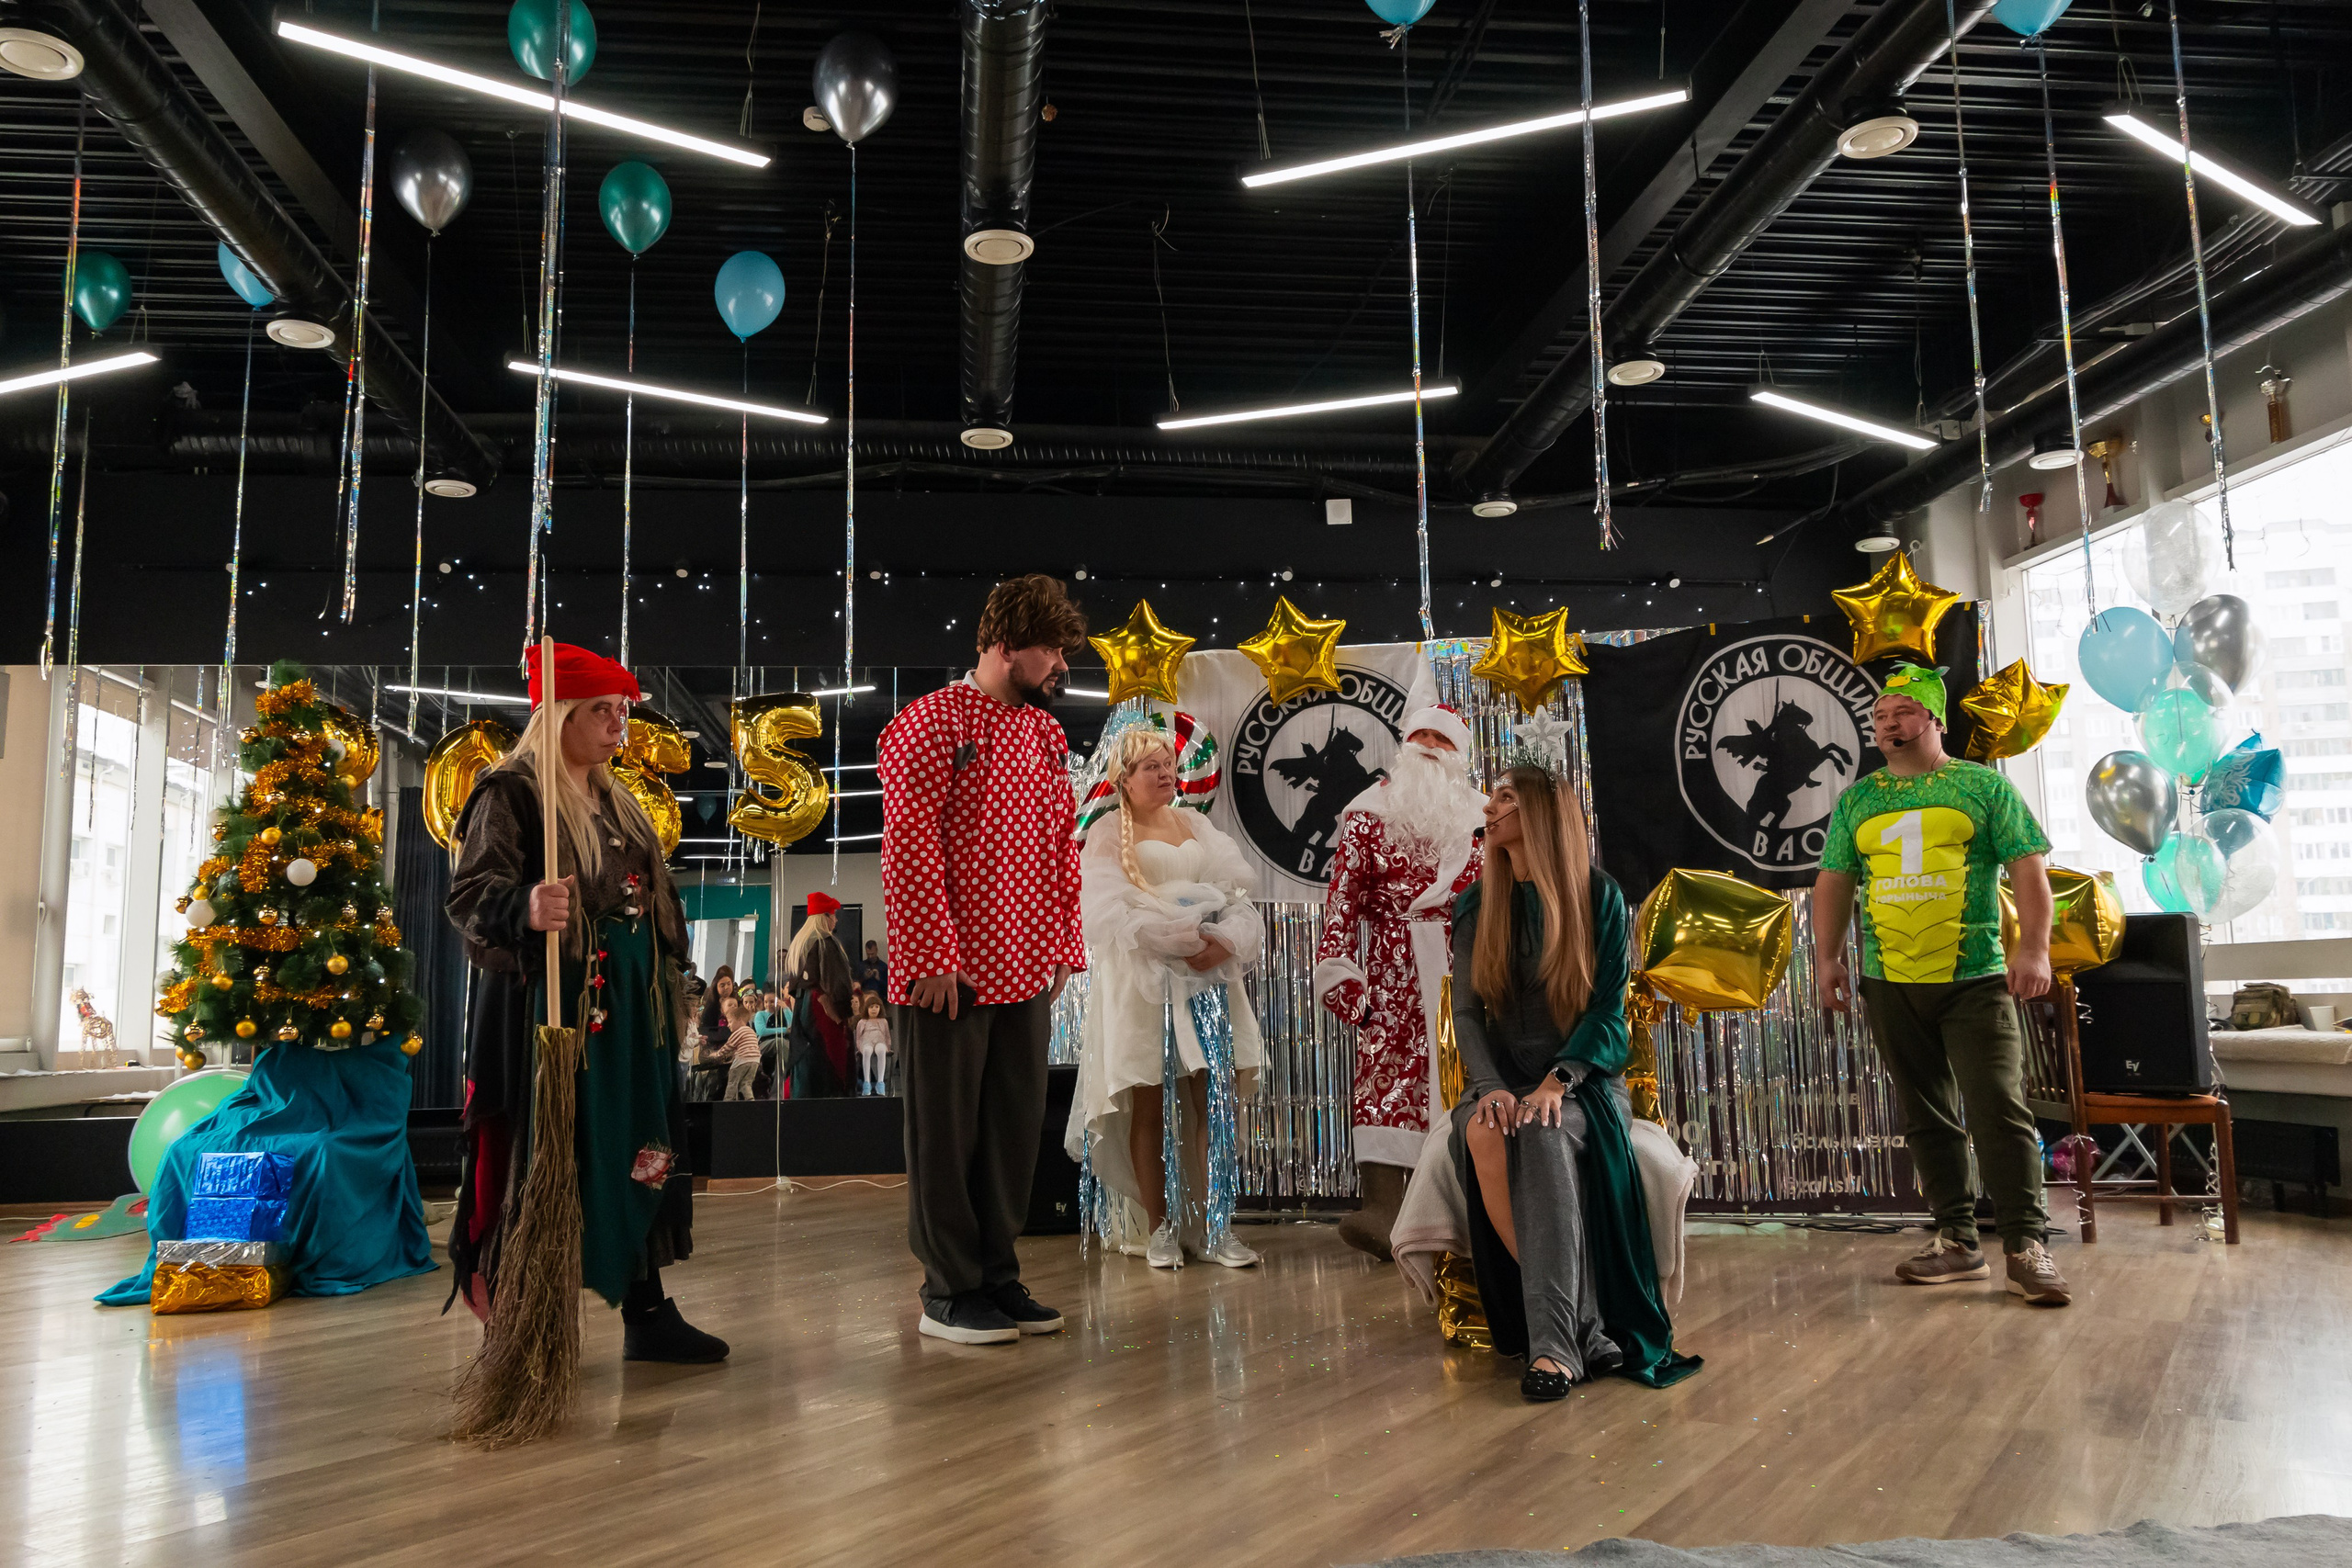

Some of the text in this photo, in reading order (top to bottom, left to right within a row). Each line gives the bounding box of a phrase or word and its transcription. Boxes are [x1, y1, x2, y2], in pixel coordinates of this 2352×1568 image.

[1685, 647, 1770, 760] РУССКАЯ
[1881, 810, 1923, 874] 1
[1875, 874, 1948, 893] ГОЛОВА
[1875, 891, 1947, 905] ГОРЫНЫЧА
[2125, 1059, 2140, 1073] EV
[1056, 1201, 1068, 1213] EV
